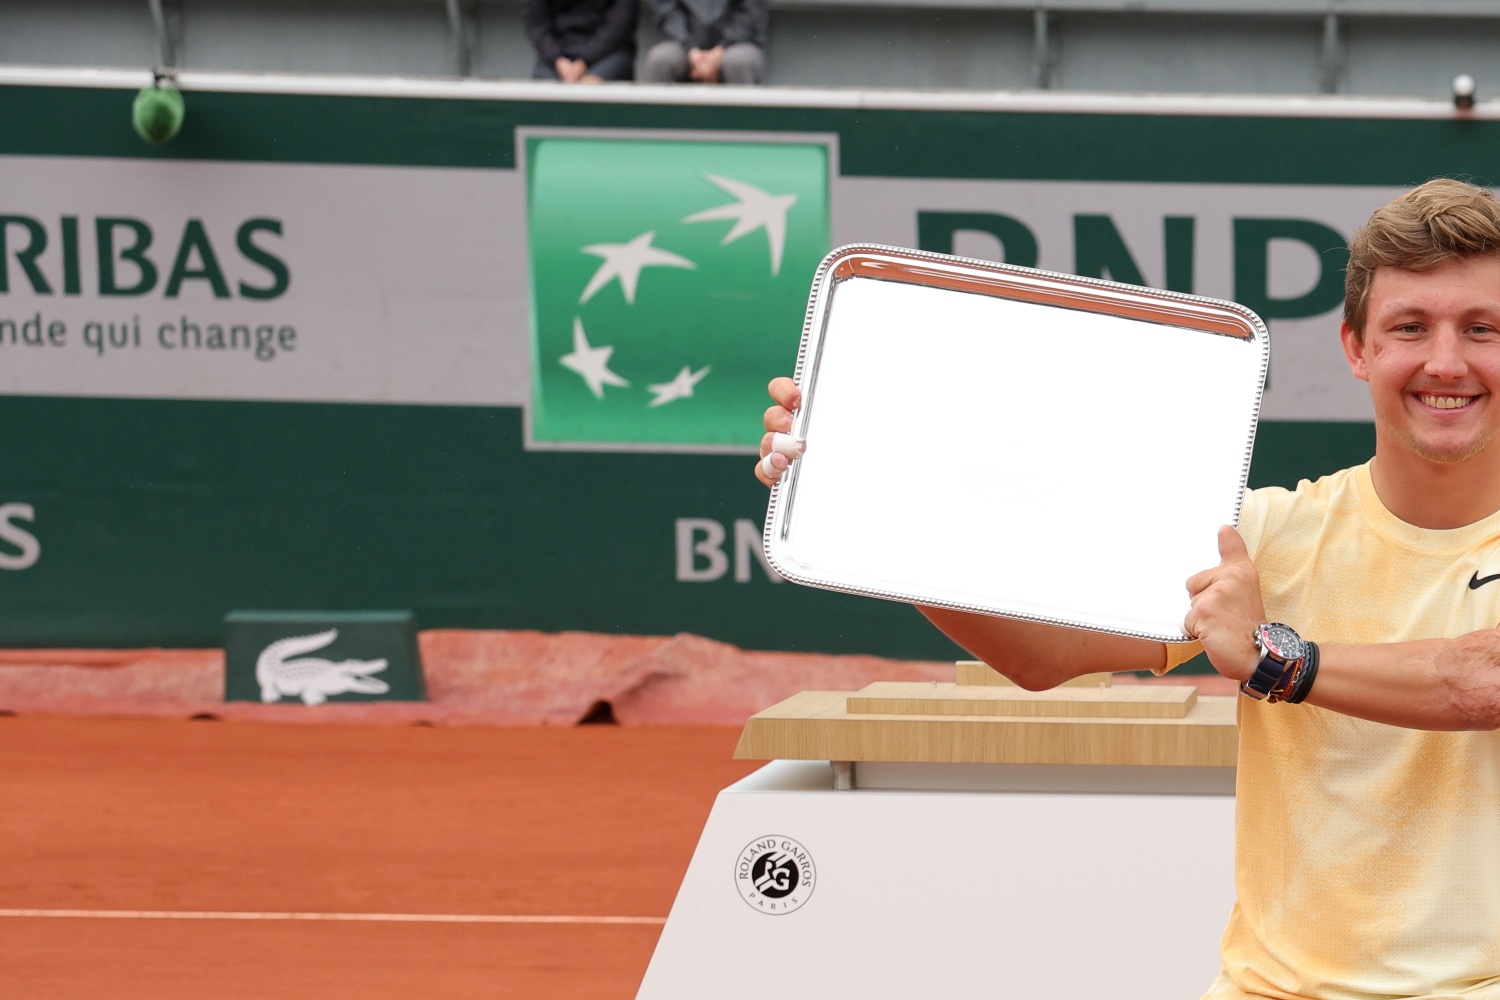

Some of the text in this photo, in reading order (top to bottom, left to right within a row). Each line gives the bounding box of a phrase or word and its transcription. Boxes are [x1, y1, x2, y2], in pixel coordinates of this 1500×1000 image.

[0, 214, 291, 302] RIBAS
[83, 314, 141, 357] qui
[157, 314, 298, 362] change
[740, 839, 812, 888] ROLAND GARROS
[748, 892, 798, 910] PARIS
